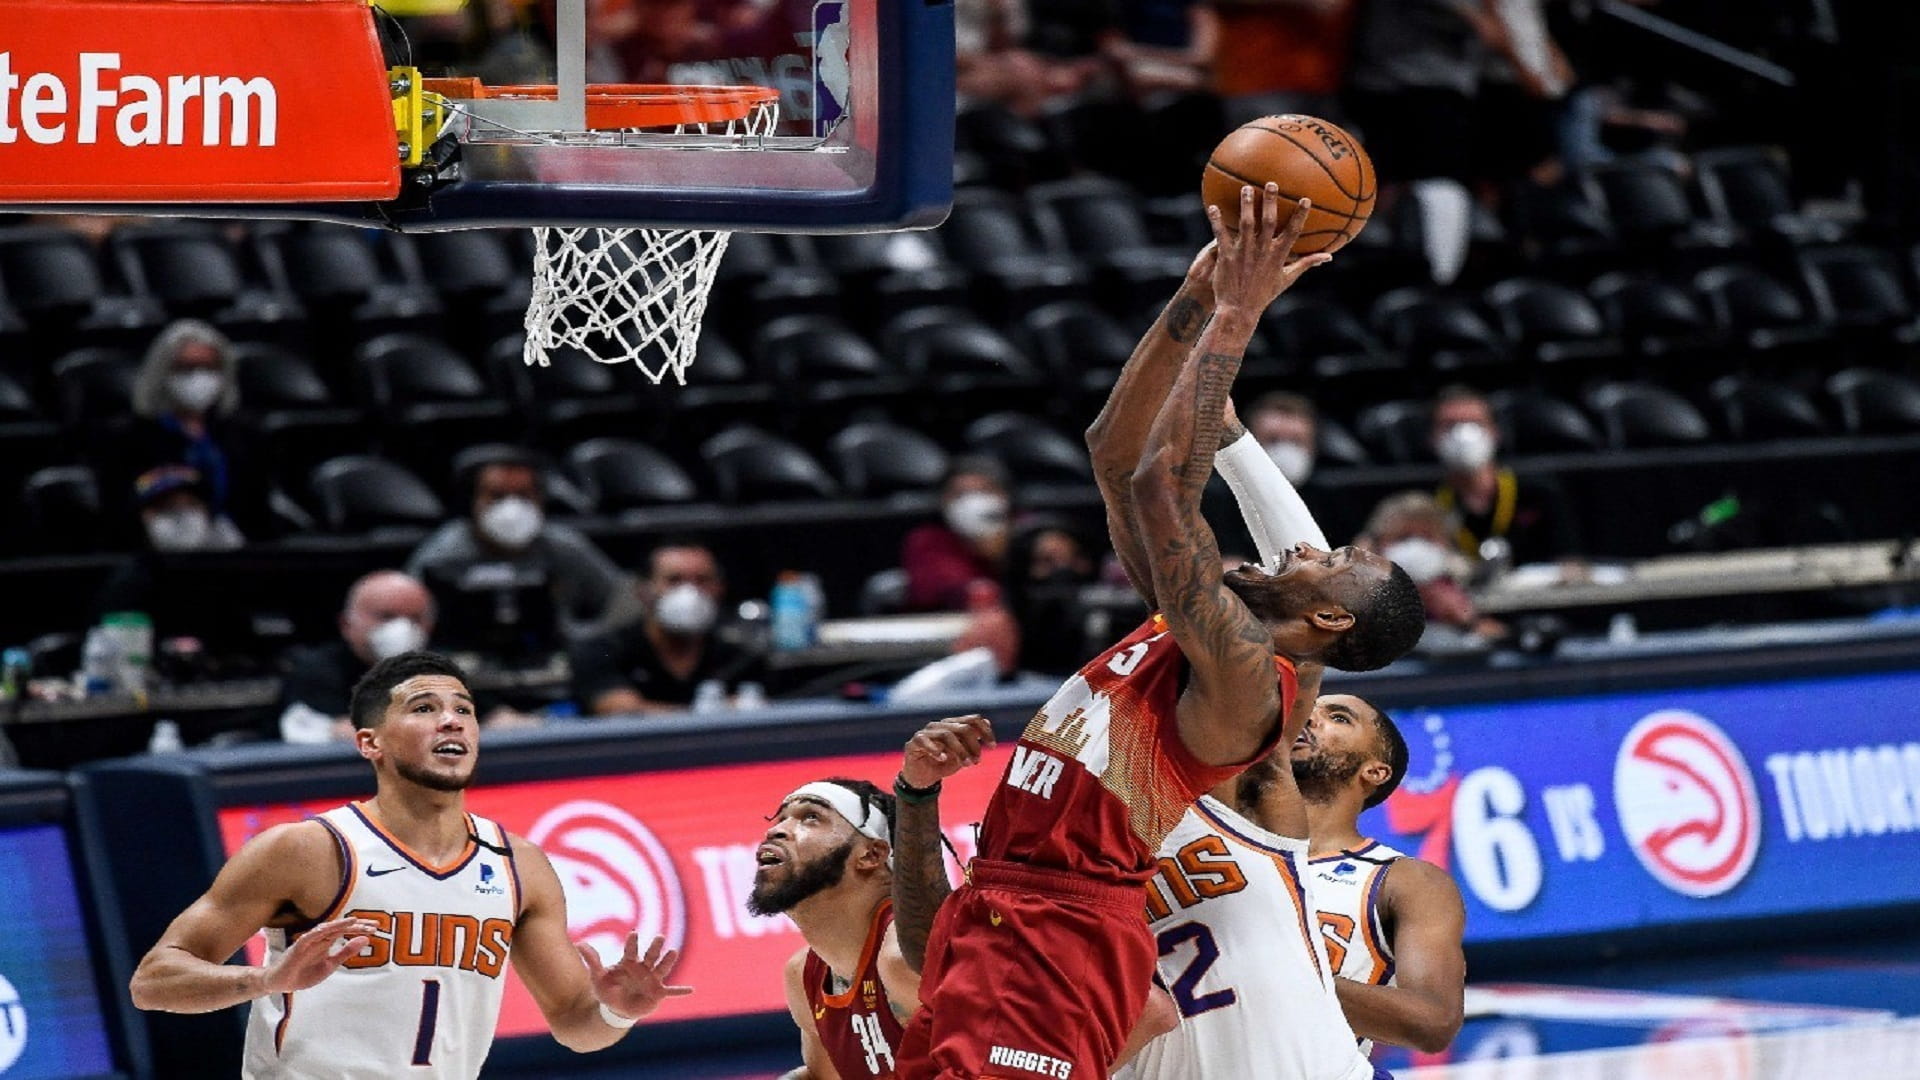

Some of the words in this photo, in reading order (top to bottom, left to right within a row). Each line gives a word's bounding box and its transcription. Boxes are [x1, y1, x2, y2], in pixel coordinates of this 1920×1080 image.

[343, 909, 513, 979] SUNS
[411, 979, 440, 1066] 1
[851, 1012, 895, 1074] 34
[989, 1045, 1072, 1080] NUGGETS
